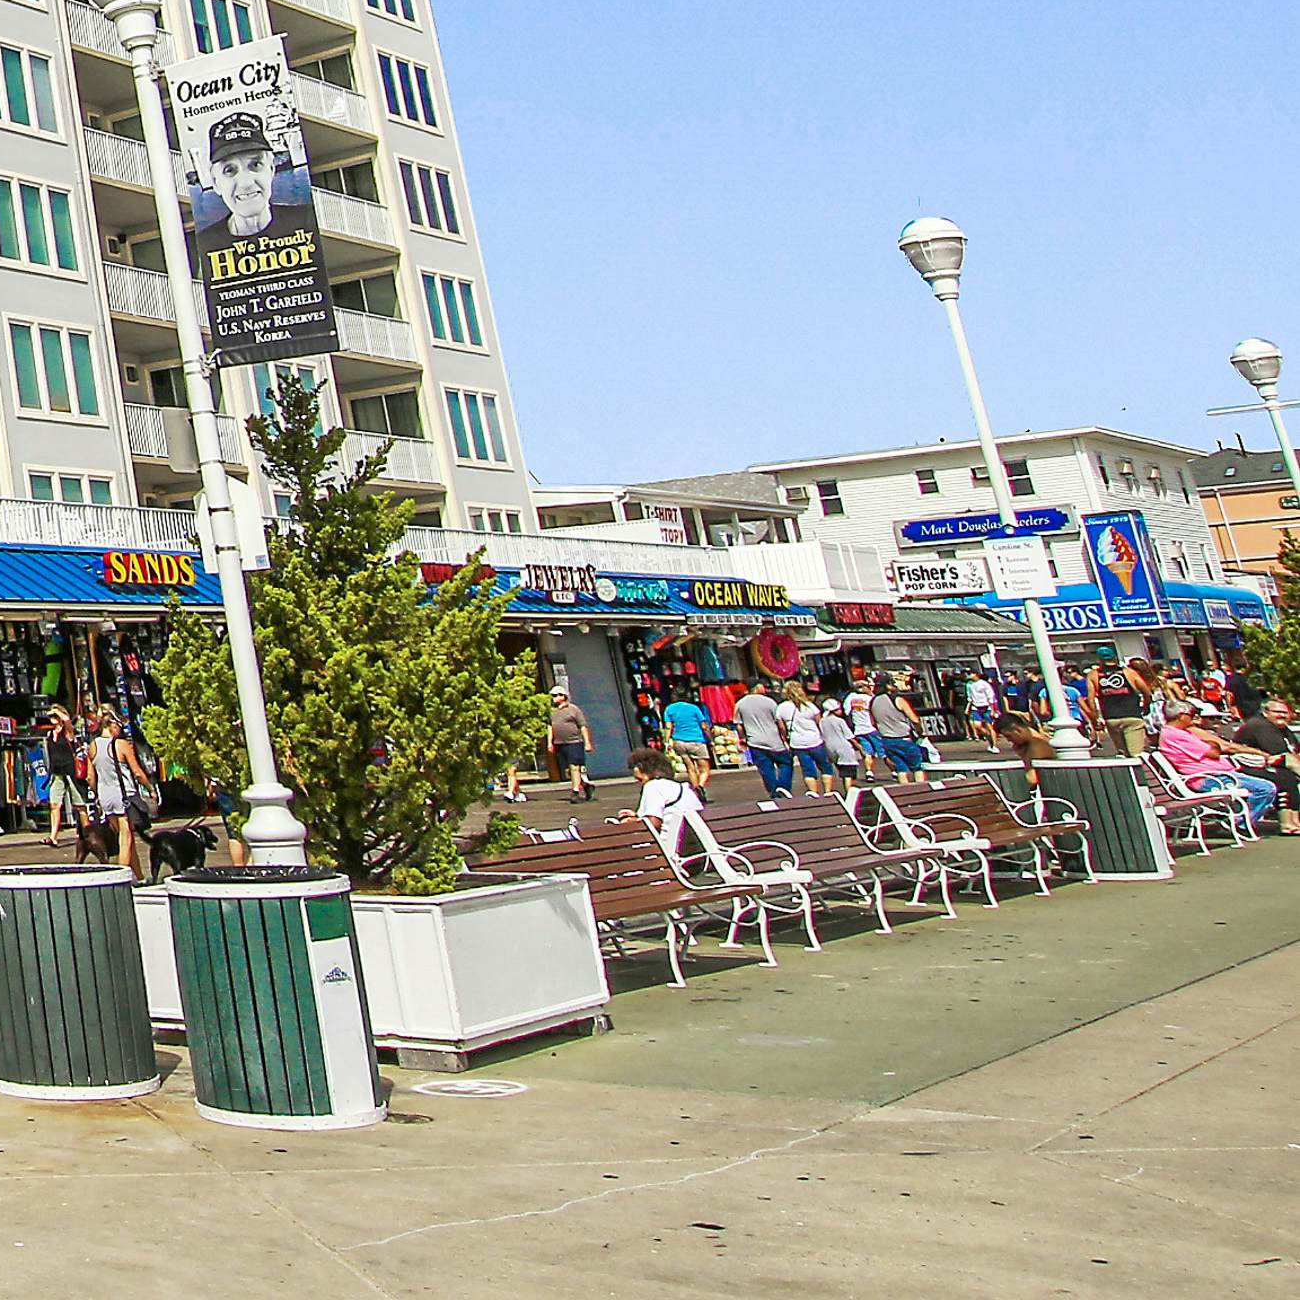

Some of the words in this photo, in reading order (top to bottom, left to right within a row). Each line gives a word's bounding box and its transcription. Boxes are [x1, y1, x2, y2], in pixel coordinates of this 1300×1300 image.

[177, 76, 233, 103] Ocean
[239, 61, 280, 88] City
[182, 97, 242, 118] Hometown
[232, 240, 256, 255] We
[258, 229, 313, 251] Proudly
[207, 244, 316, 282] Honor
[219, 286, 256, 301] YEOMAN
[256, 281, 286, 294] THIRD
[287, 276, 314, 289] CLASS
[216, 304, 247, 323] JOHN
[249, 297, 264, 314] T.
[265, 291, 323, 311] GARFIELD
[218, 322, 241, 336] U.S.
[243, 318, 272, 333] NAVY
[273, 310, 327, 328] RESERVES
[254, 330, 292, 344] KOREA
[921, 523, 954, 537] Mark
[958, 518, 1002, 534] Douglas
[108, 551, 196, 586] SANDS
[525, 563, 597, 592] JEWELRY
[897, 563, 959, 583] Fisher's
[694, 581, 743, 607] OCEAN
[746, 584, 791, 608] WAVES
[905, 582, 926, 591] POP
[929, 581, 957, 590] CORN
[1041, 605, 1107, 631] BROS.
